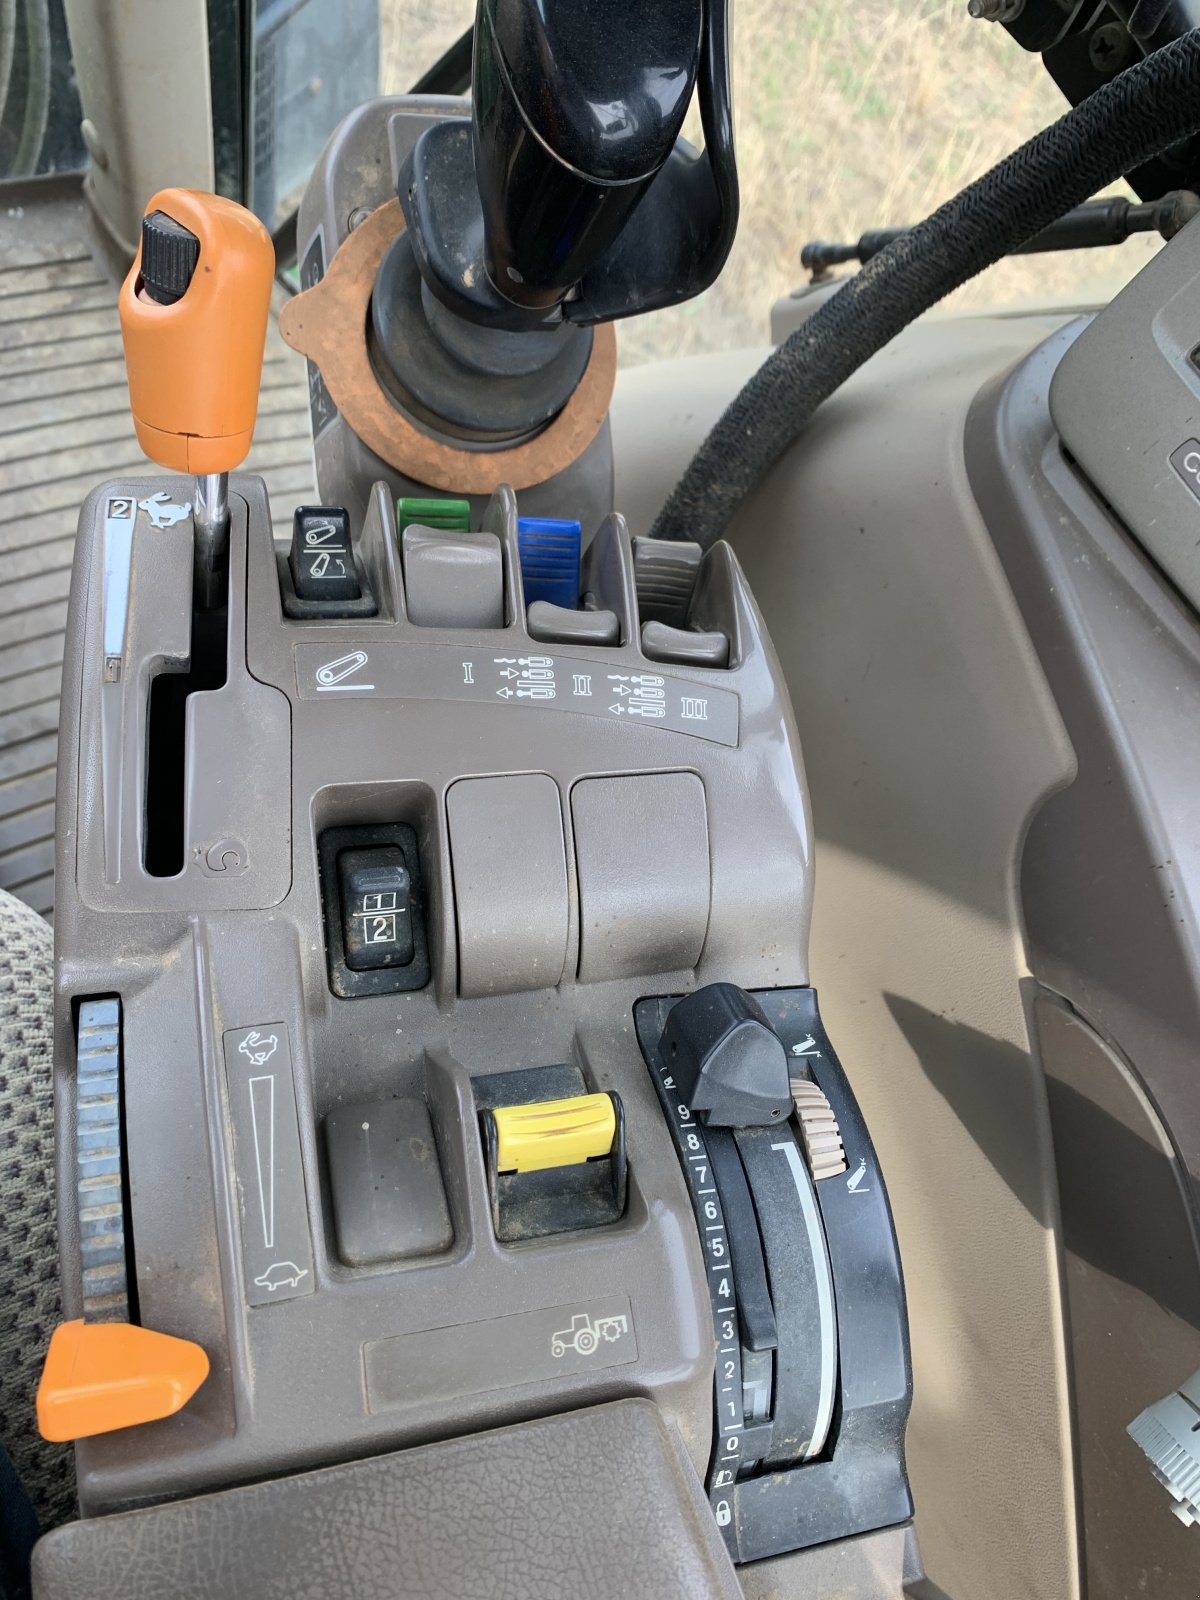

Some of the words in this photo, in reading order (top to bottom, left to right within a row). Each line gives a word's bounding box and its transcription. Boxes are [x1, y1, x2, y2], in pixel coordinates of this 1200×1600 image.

[112, 500, 129, 518] 2
[572, 674, 592, 696] II
[681, 697, 708, 720] III
[373, 894, 382, 909] 1
[373, 917, 388, 941] 2
[677, 1104, 691, 1120] 9
[687, 1133, 700, 1150] 8
[695, 1166, 707, 1184] 7
[705, 1201, 717, 1219] 6
[712, 1237, 725, 1257] 5
[718, 1278, 731, 1298] 4
[722, 1320, 734, 1340] 3
[724, 1362, 735, 1380] 2
[727, 1401, 736, 1417] 1
[726, 1436, 739, 1451] 0
